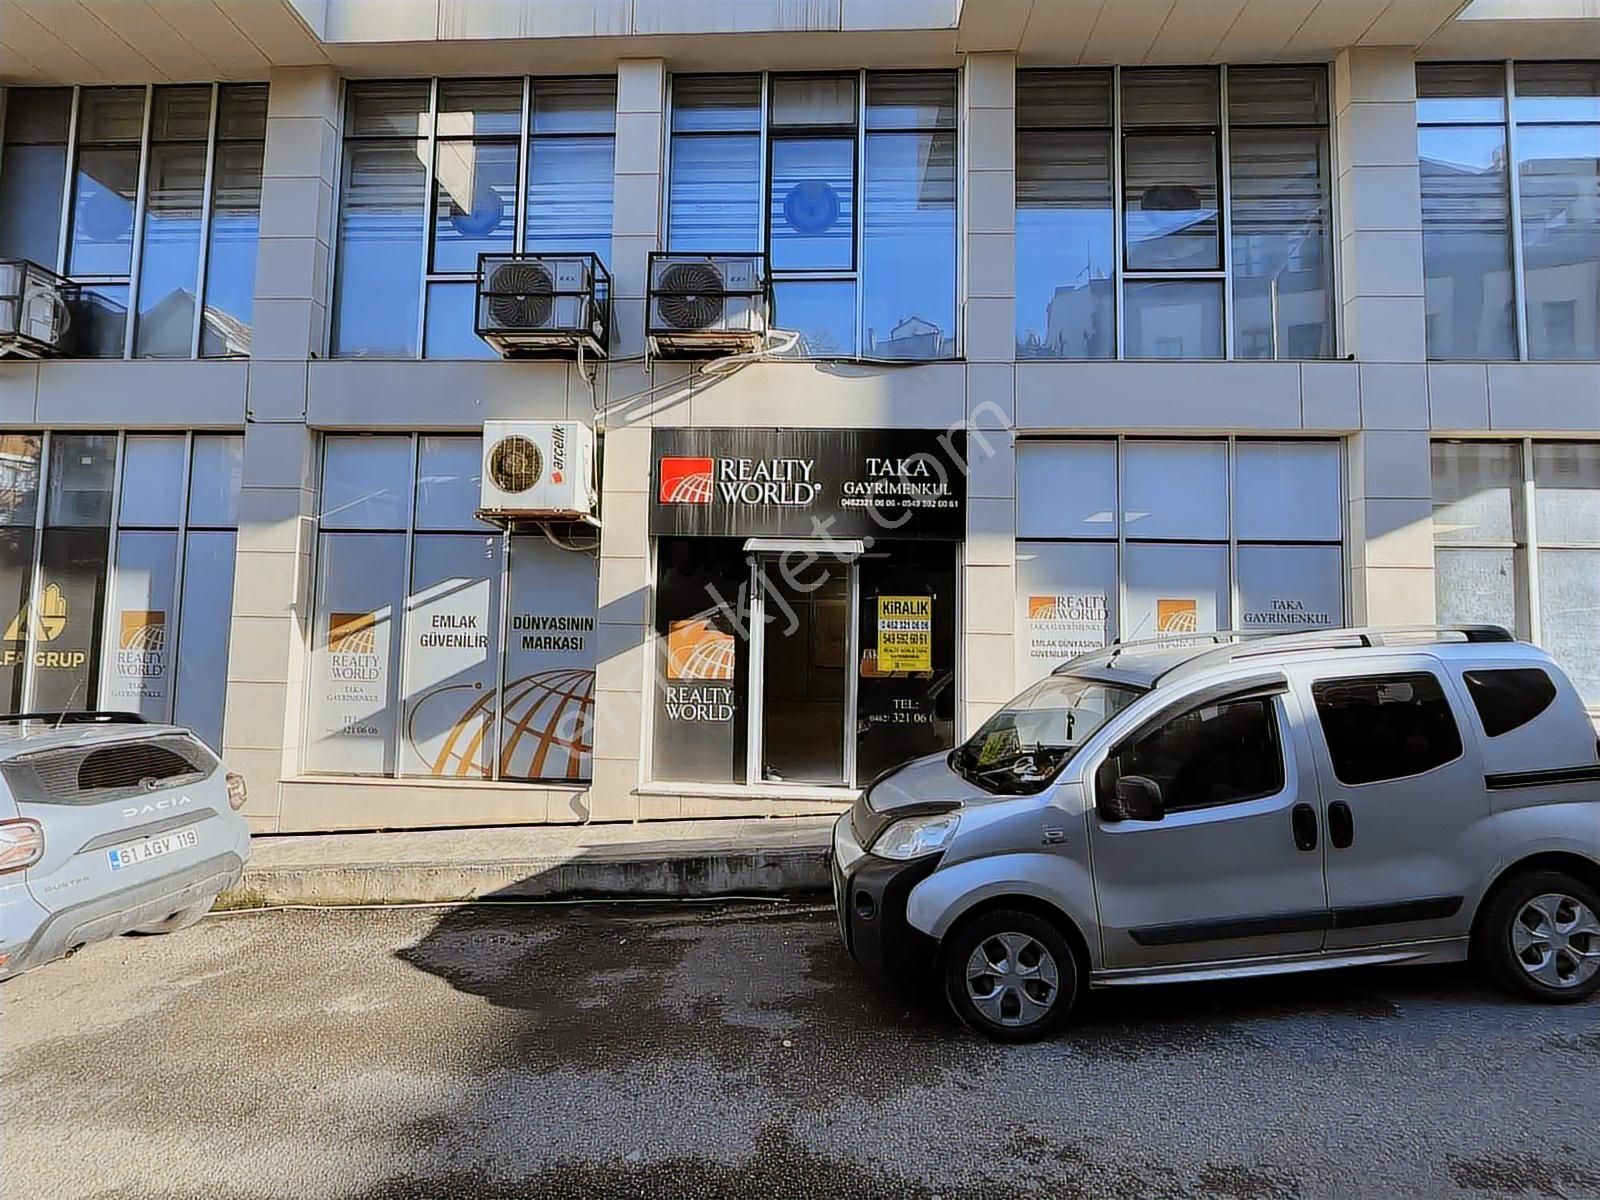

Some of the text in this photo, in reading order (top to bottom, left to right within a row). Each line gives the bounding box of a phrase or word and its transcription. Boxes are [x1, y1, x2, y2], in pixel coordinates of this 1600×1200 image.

[719, 458, 814, 481] REALTY
[866, 458, 930, 477] TAKA
[1057, 596, 1108, 608] REALTY
[1270, 600, 1304, 610] TAKA
[432, 614, 477, 629] EMLAK
[513, 614, 594, 631] DÜNYASININ
[420, 631, 489, 648] GÜVENİLİR
[522, 636, 583, 650] MARKASI
[34, 651, 85, 668] GRUP
[118, 651, 163, 664] REALTY
[332, 655, 379, 668] REALTY
[666, 687, 732, 704] REALTY
[893, 712, 910, 723] 321
[122, 796, 192, 818] DACIA
[120, 831, 196, 864] 61 AGV 119
